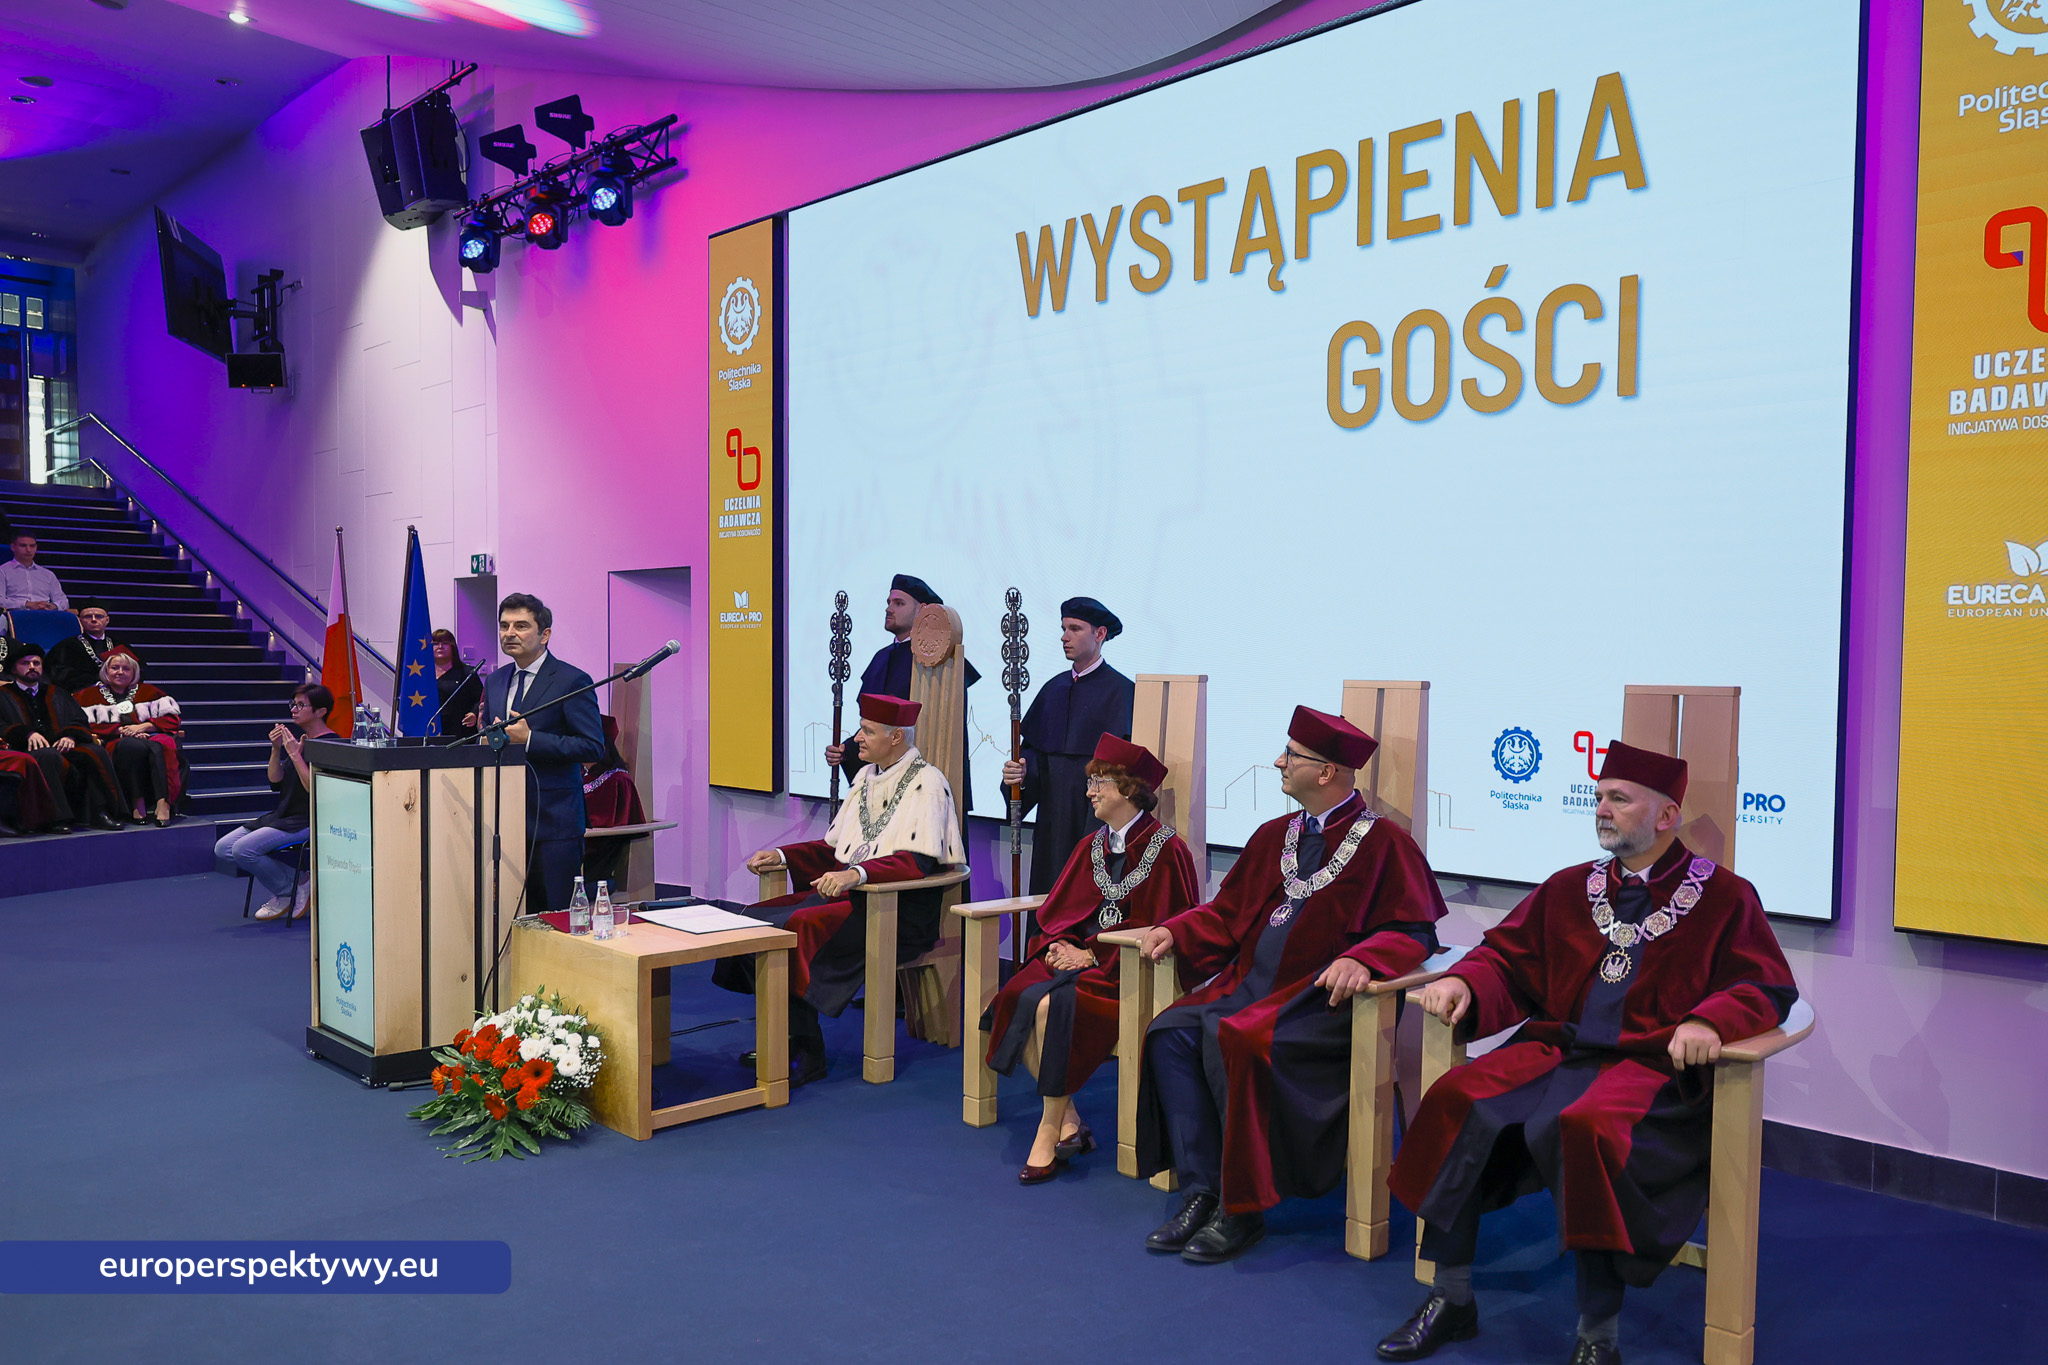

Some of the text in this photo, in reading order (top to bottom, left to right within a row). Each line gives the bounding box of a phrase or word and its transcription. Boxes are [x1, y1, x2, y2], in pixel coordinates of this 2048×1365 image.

[1016, 72, 1648, 317] WYSTĄPIENIA
[1326, 264, 1640, 429] GOŚCI
[718, 363, 762, 381] Politechnika
[1974, 348, 2046, 380] UCZE
[1947, 417, 2019, 436] INICJATYWA
[724, 495, 761, 511] UCZELNIA
[719, 512, 761, 528] BADAWCZA
[1947, 583, 2047, 605] EURECA
[1947, 608, 2023, 618] EUROPEAN
[1490, 790, 1542, 802] Politechnika
[1743, 792, 1786, 813] PRO
